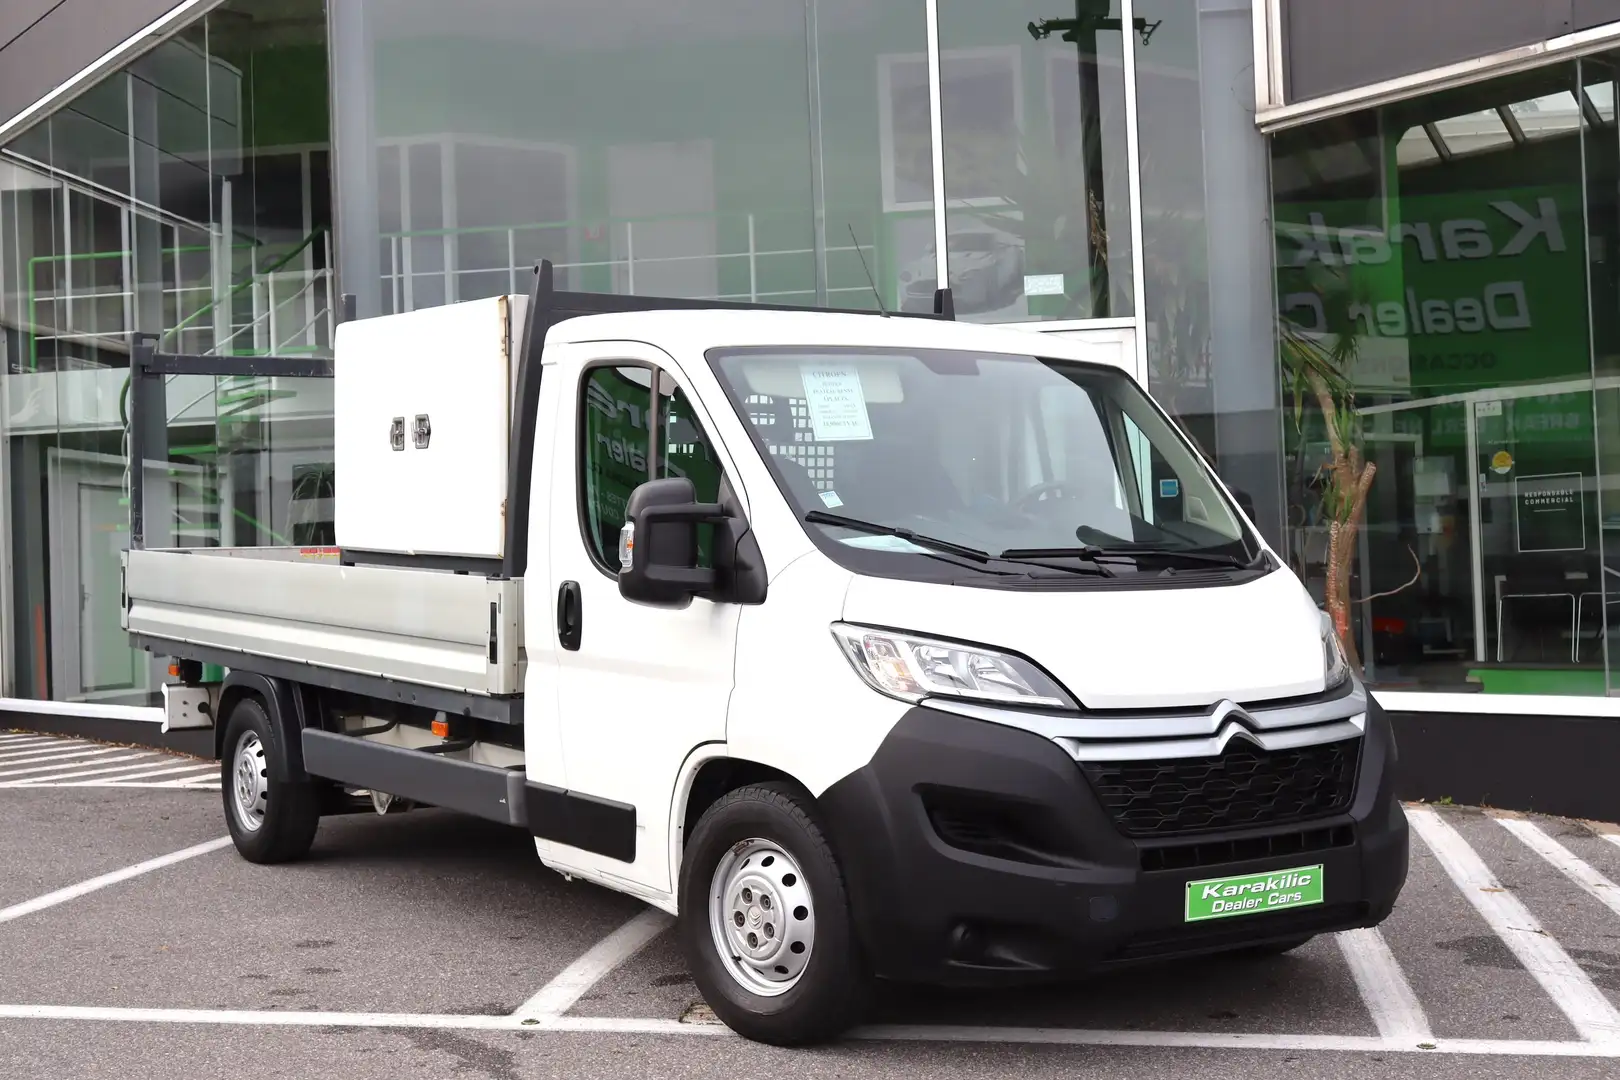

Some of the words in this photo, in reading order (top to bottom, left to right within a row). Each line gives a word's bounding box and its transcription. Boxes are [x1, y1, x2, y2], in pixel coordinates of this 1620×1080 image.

[1524, 496, 1574, 505] COMMERCIAL
[1201, 873, 1312, 899] Karakilic
[1211, 897, 1263, 913] Dealer
[1267, 891, 1302, 905] Cars
